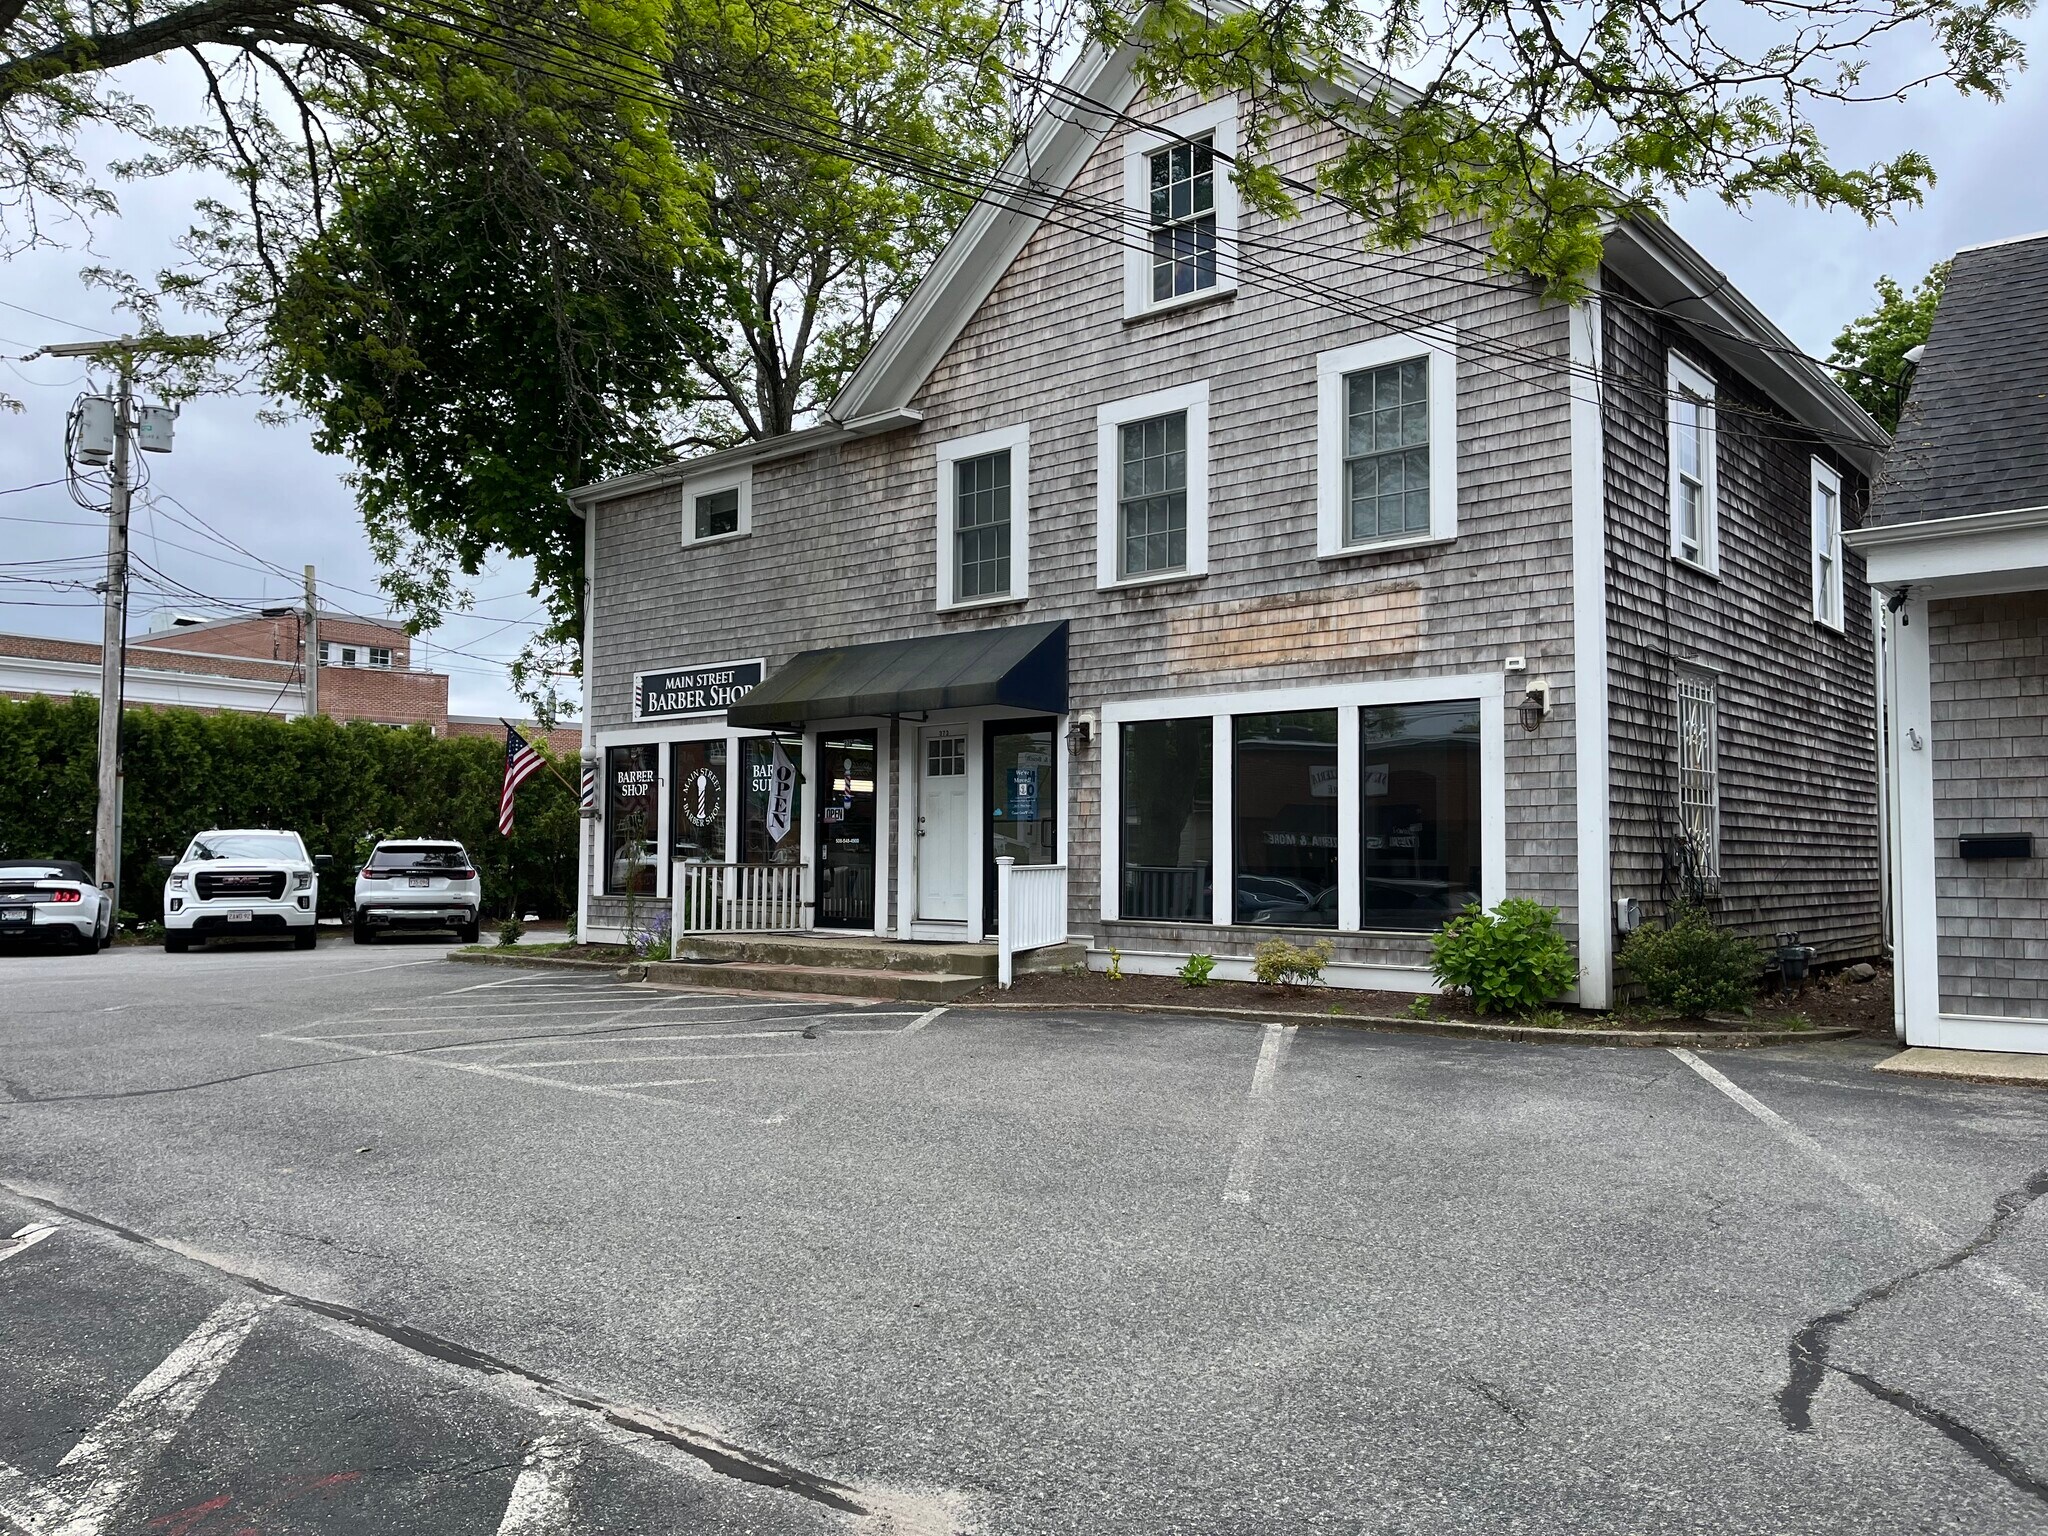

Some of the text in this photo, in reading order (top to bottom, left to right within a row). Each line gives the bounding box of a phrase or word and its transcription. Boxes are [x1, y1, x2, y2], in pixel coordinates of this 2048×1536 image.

[665, 671, 735, 690] MAIN STREET
[648, 690, 706, 712] BARBER
[617, 770, 654, 784] BARBER
[683, 767, 721, 794] MAIN STREET
[621, 783, 649, 797] SHOP
[770, 765, 792, 829] OPEN
[683, 802, 721, 827] BARBER SHOP
[826, 808, 843, 820] OPEN
